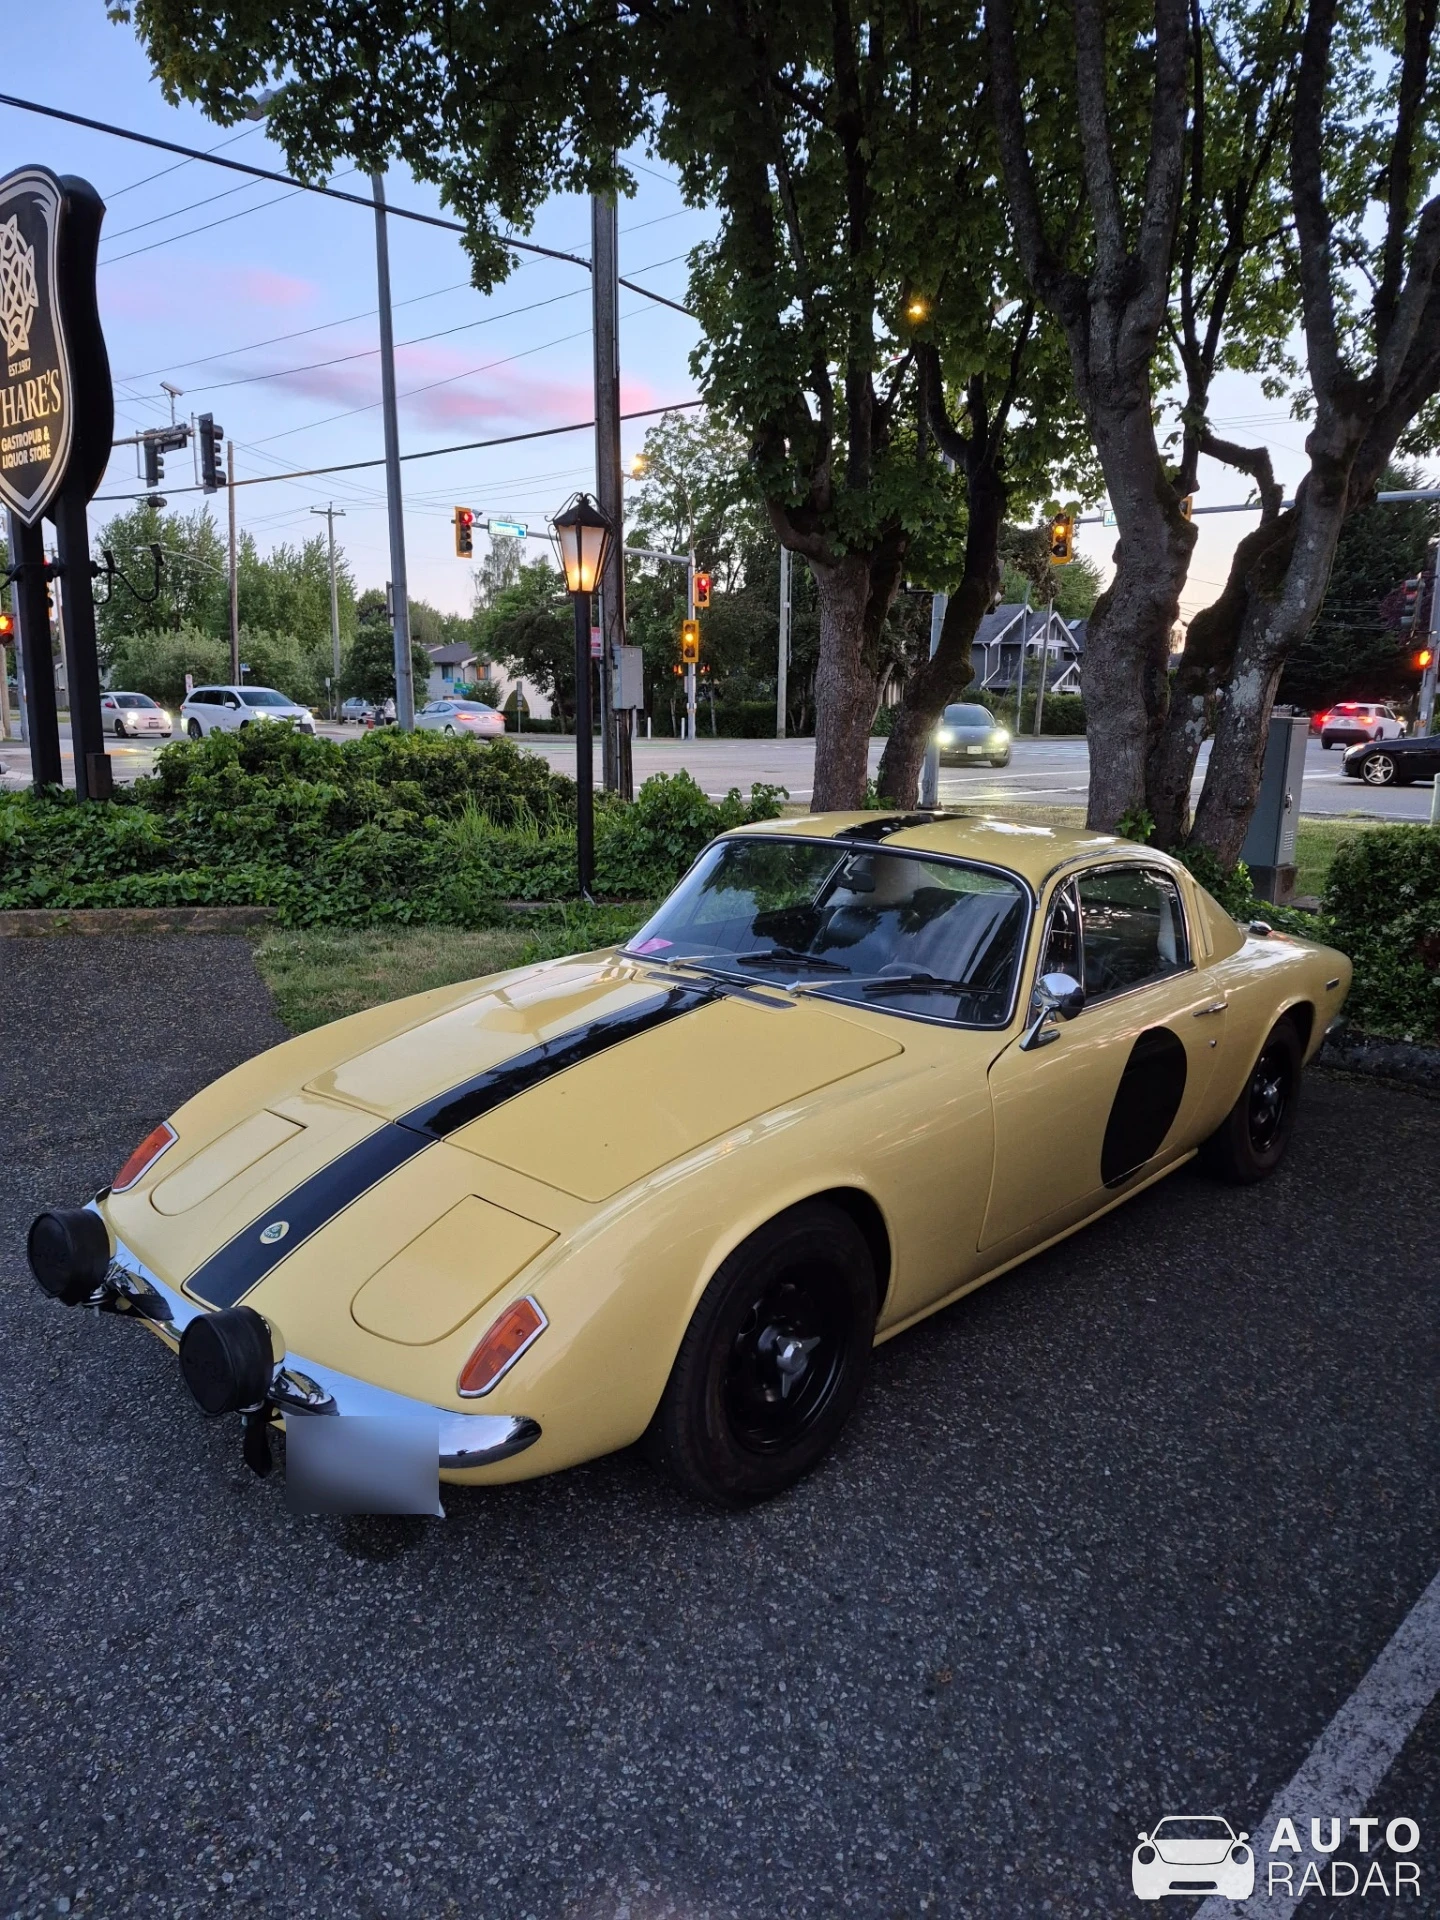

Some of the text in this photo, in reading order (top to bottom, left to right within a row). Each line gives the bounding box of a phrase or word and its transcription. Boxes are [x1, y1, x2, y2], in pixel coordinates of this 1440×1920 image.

[0, 369, 61, 428] HARE'S
[1, 425, 50, 452] GASTROPUB &
[2, 443, 51, 469] LIQUOR STORE
